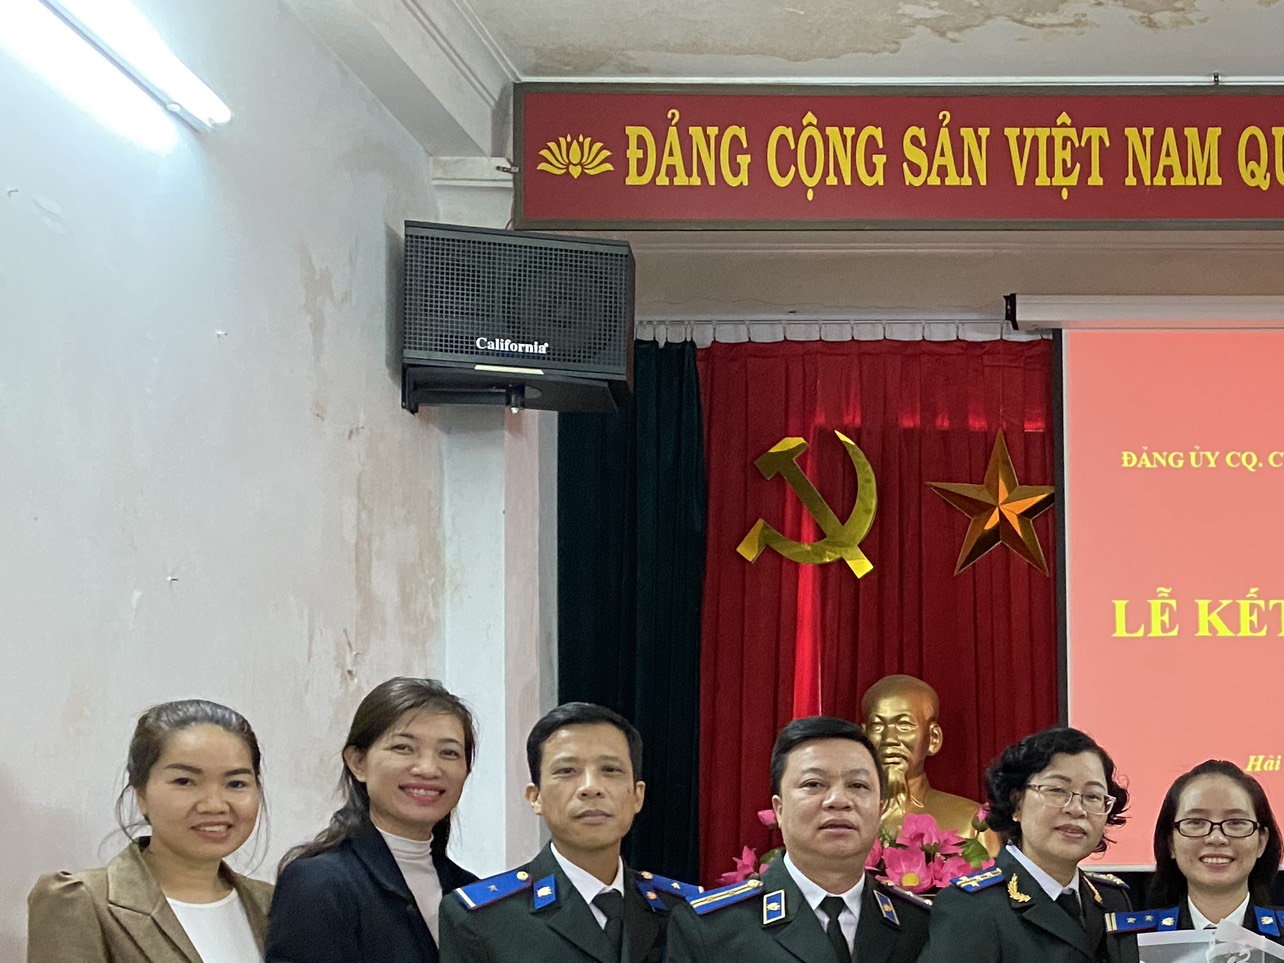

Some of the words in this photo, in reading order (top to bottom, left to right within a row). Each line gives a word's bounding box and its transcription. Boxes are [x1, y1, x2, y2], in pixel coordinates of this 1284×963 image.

[625, 108, 751, 186] ĐẢNG
[766, 110, 887, 201] CỘNG
[902, 110, 991, 187] SẢN
[1004, 110, 1110, 201] VIỆT
[1124, 126, 1222, 186] NAM
[476, 337, 549, 354] California
[1121, 446, 1185, 468] ĐẢNG
[1190, 446, 1221, 468] ỦY
[1225, 451, 1263, 472] CQ.
[1111, 587, 1179, 638] LỄ
